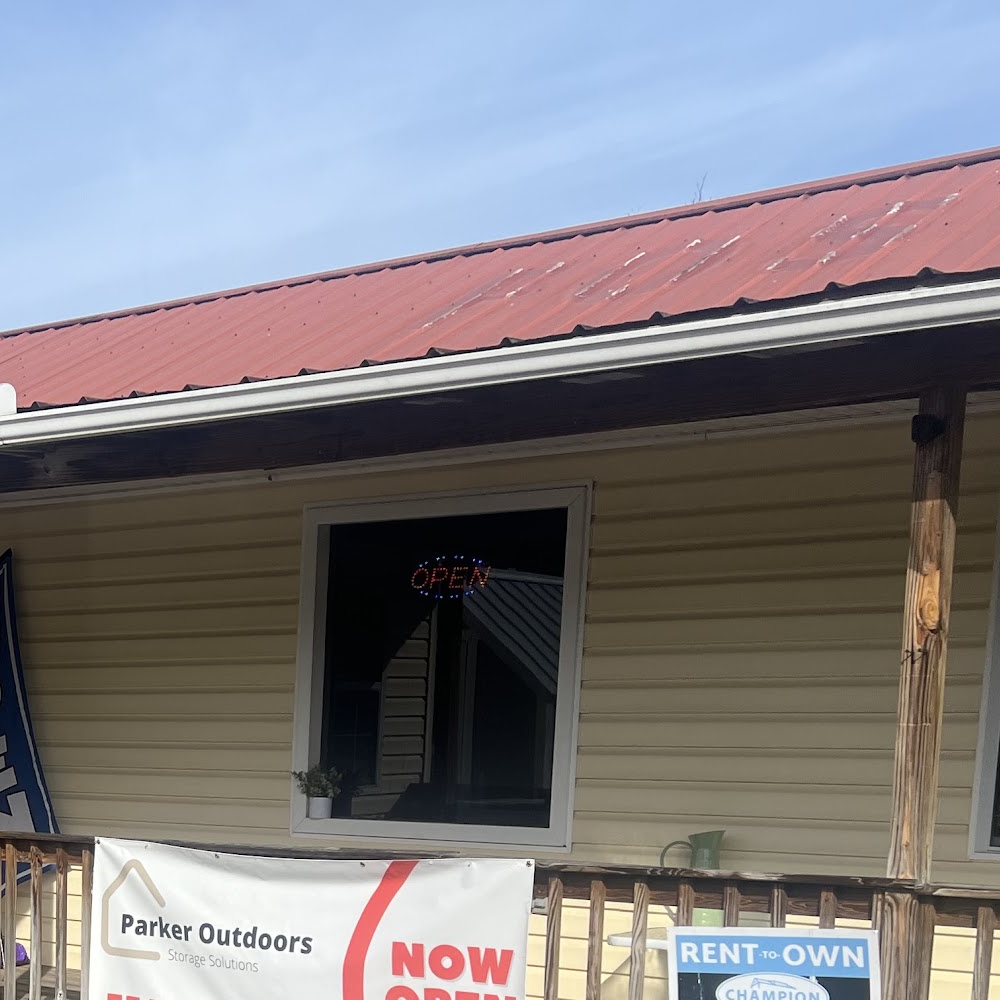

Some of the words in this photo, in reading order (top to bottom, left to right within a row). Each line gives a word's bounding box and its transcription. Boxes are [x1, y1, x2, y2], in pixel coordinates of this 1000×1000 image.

[411, 566, 491, 589] OPEN
[121, 913, 193, 942] Parker
[198, 922, 313, 955] Outdoors
[168, 949, 206, 968] Storage
[209, 954, 259, 973] Solutions
[391, 941, 515, 986] NOW
